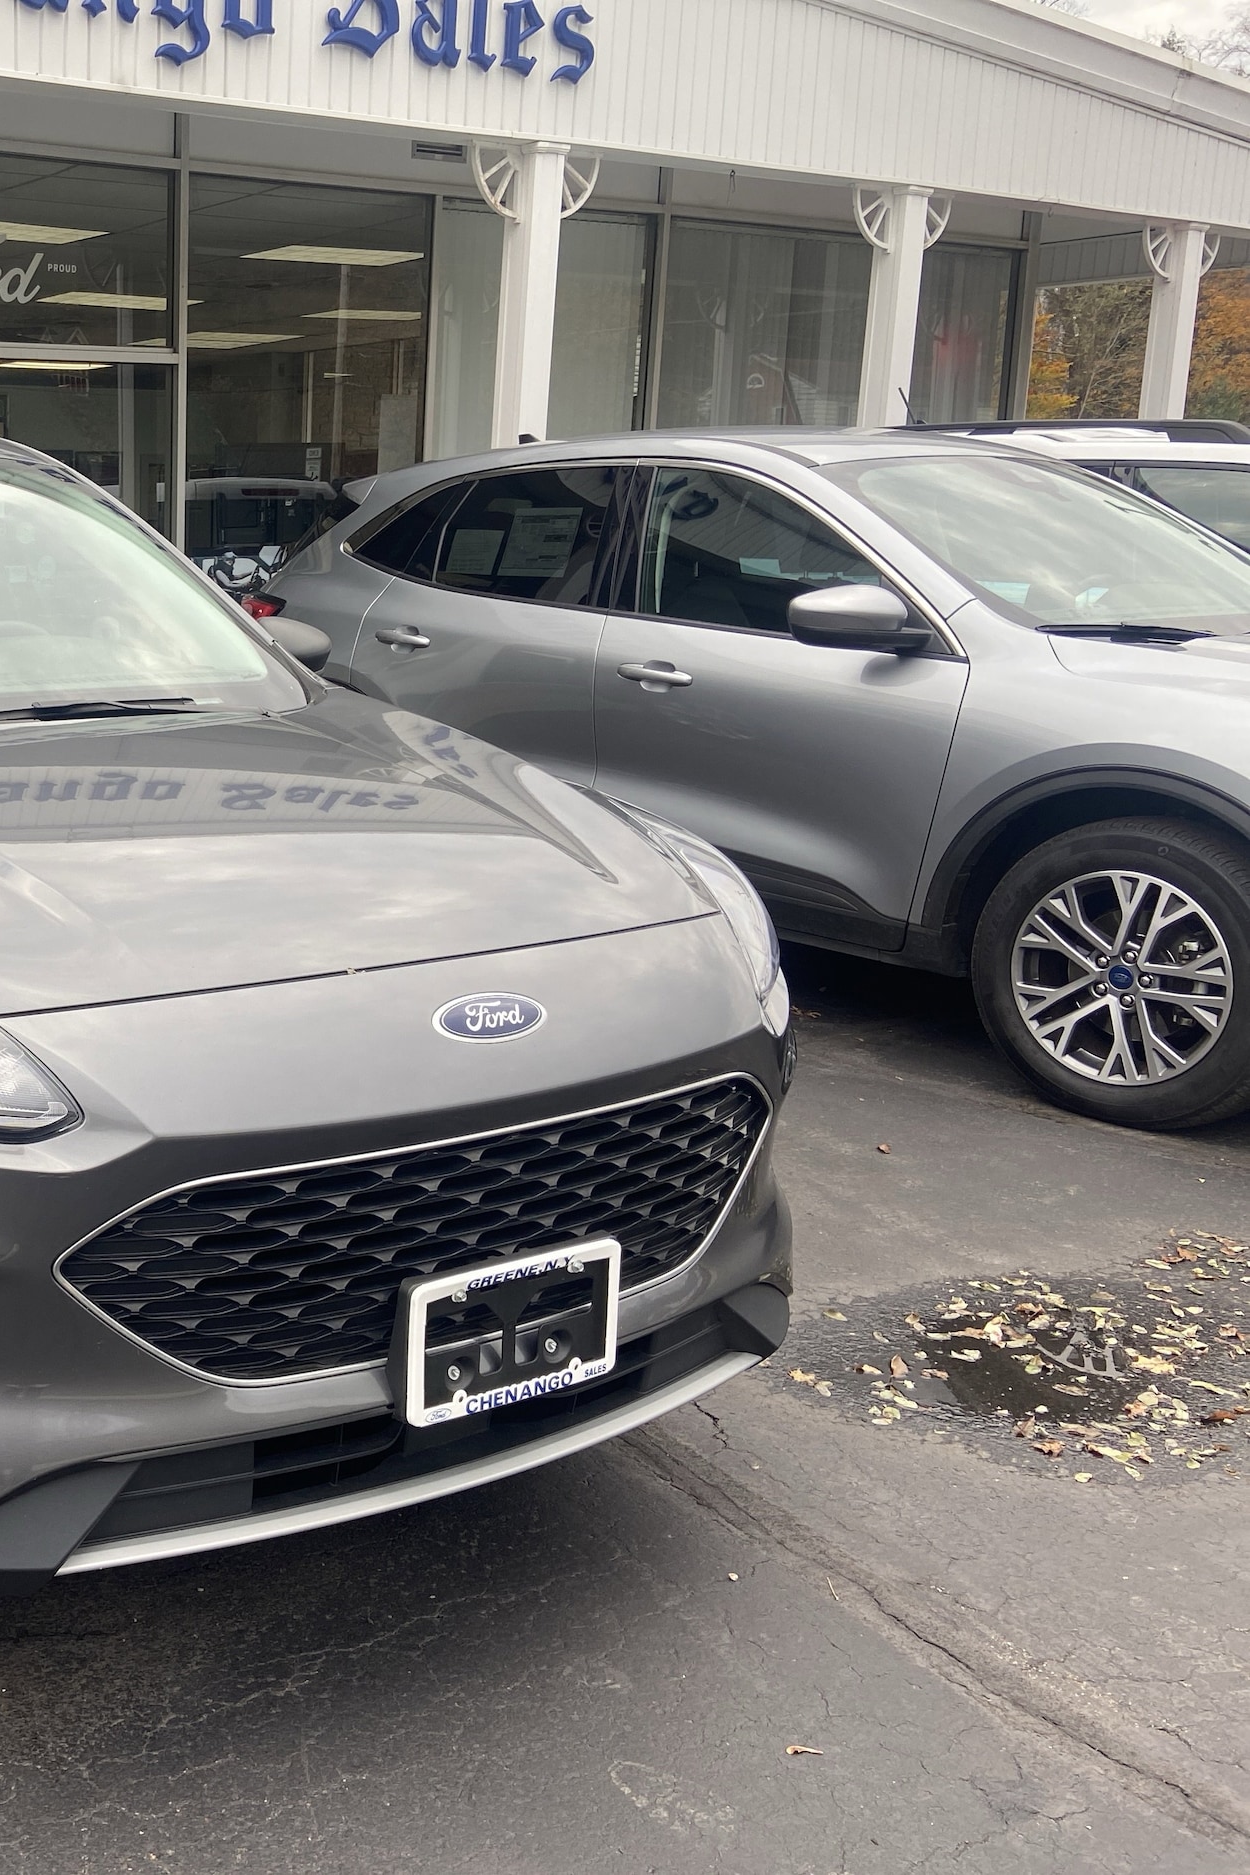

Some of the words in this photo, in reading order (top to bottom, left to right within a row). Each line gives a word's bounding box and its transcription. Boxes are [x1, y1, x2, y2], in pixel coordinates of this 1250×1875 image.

[47, 263, 77, 274] PROUD
[464, 1000, 525, 1032] Ford
[466, 1371, 573, 1415] CHENANGO
[584, 1363, 607, 1378] SALES
